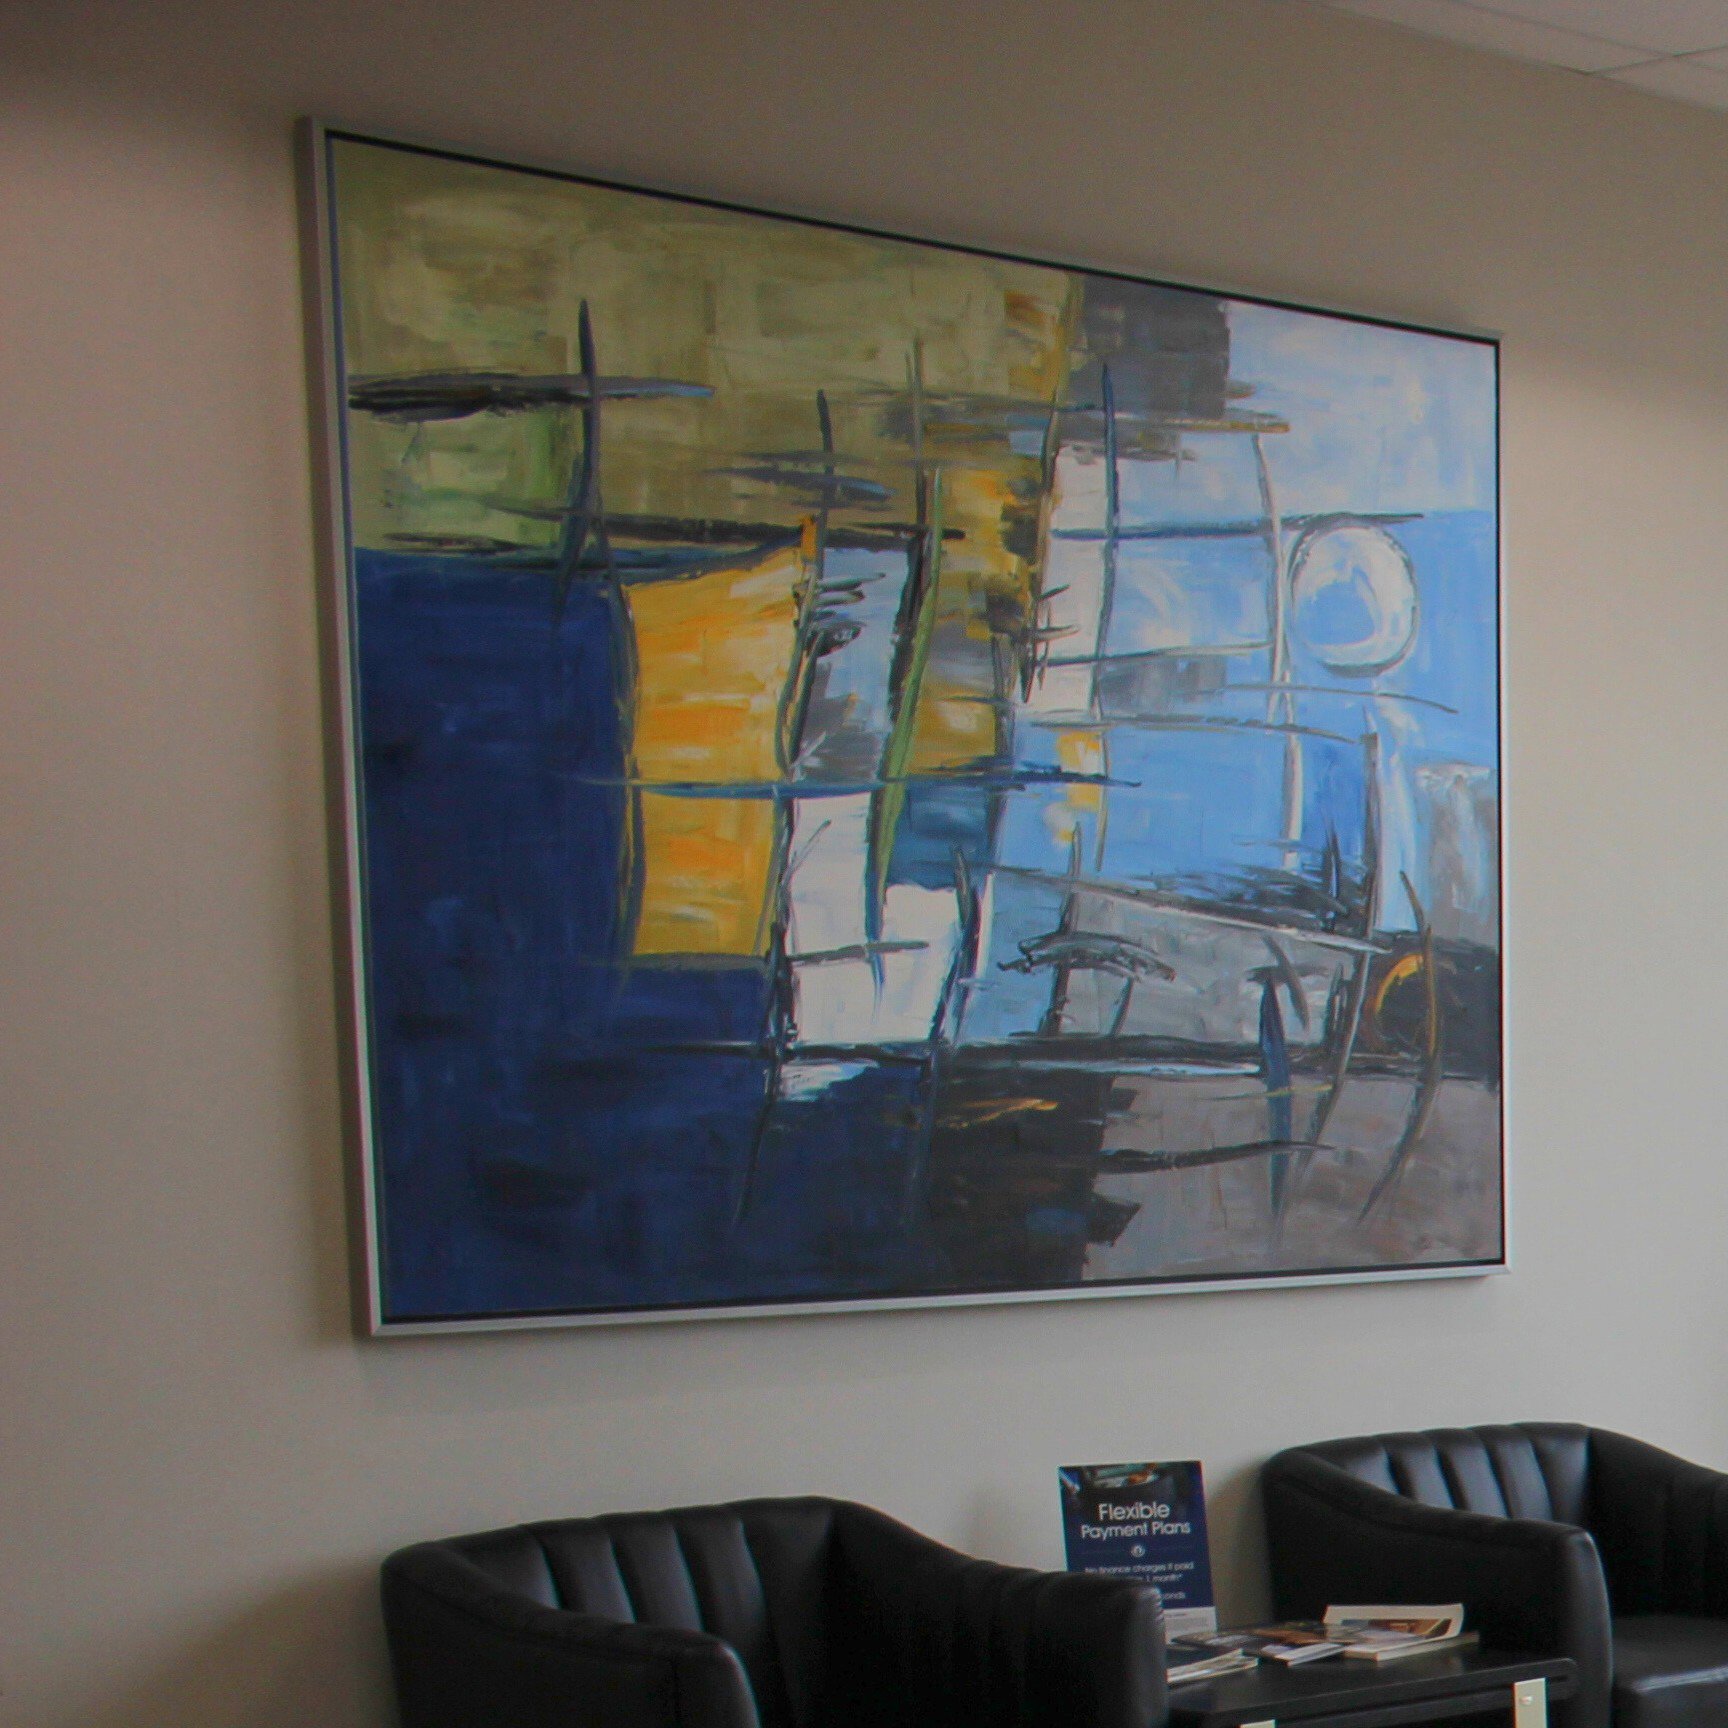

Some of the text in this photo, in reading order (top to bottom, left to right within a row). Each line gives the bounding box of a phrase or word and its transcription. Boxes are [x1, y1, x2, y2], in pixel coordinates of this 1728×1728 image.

[1099, 1502, 1170, 1521] Flexible
[1081, 1521, 1191, 1541] Payment Plans
